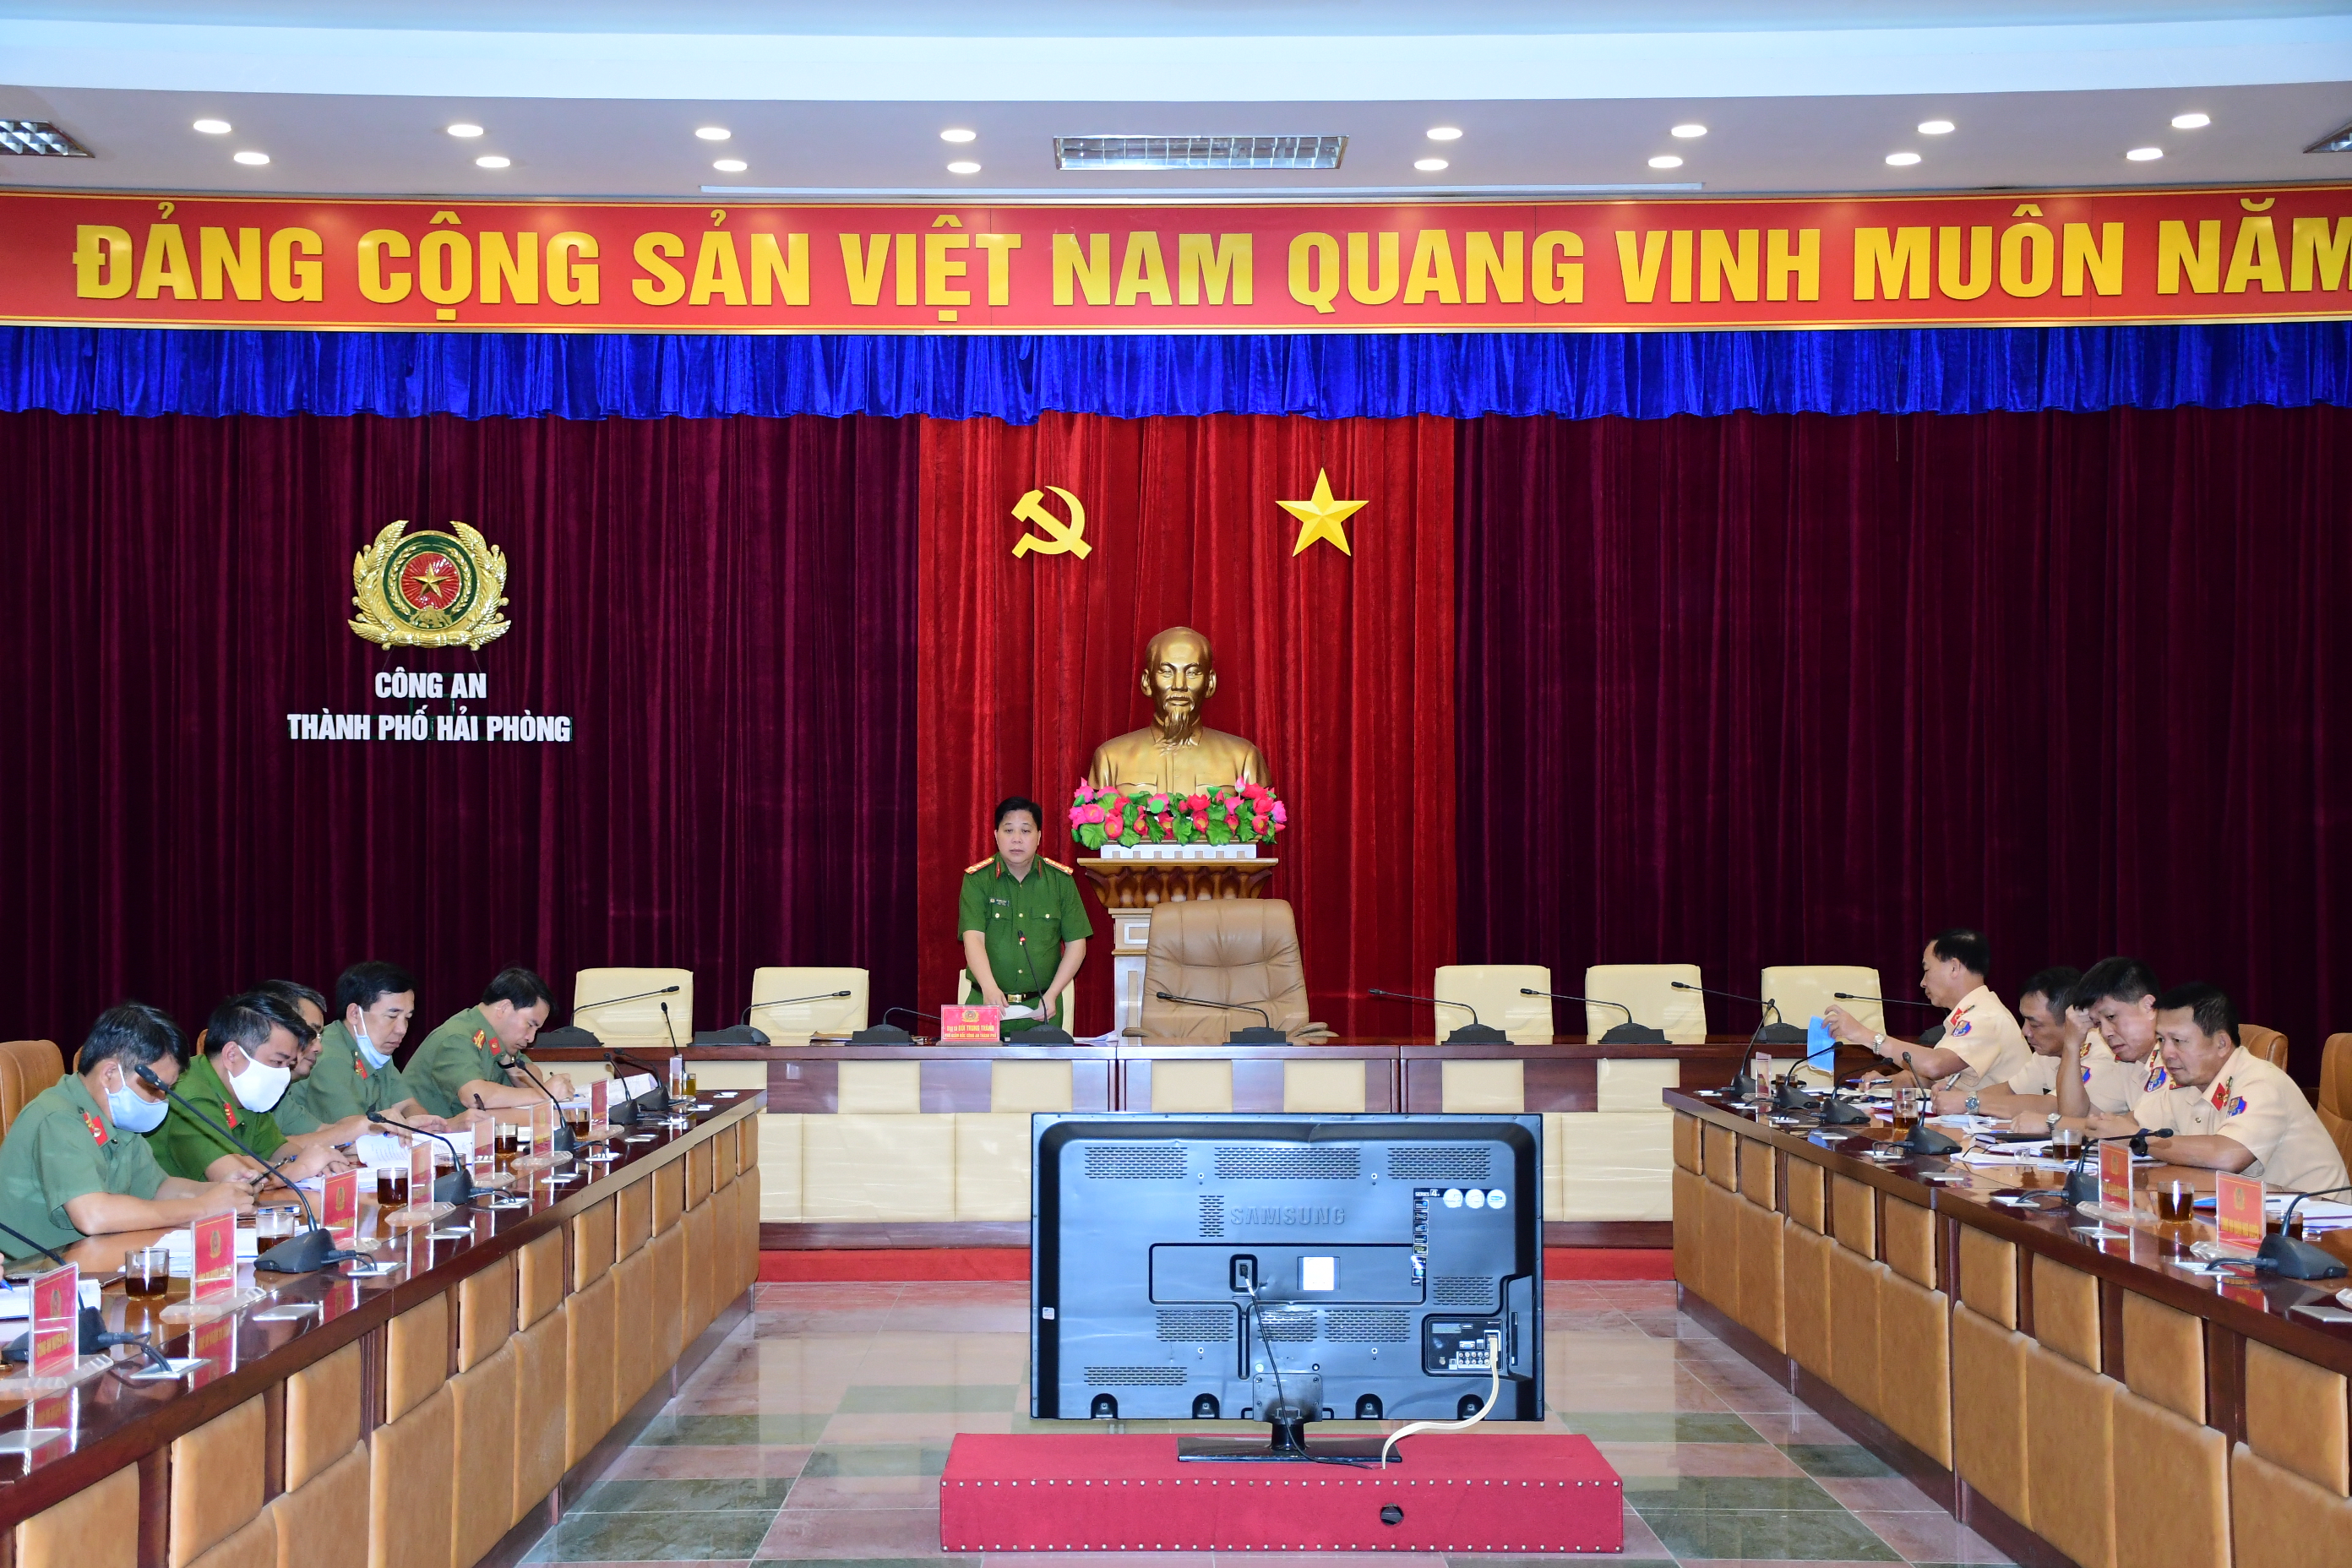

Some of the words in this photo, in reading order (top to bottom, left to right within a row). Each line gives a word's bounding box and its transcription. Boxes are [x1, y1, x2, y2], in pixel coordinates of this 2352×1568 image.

[73, 201, 324, 302] ĐẢNG
[357, 210, 601, 321] CỘNG
[631, 209, 810, 307] SẢN
[839, 214, 1021, 323] VIỆT
[1052, 231, 1254, 307] NAM
[1288, 229, 1585, 314] QUANG
[1614, 228, 1821, 303] VINH
[1853, 204, 2125, 301] MUÔN
[2156, 197, 2352, 295] NĂM
[374, 666, 444, 699] CÔNG
[449, 672, 487, 699] AN
[286, 708, 371, 740] THÀNH
[378, 704, 428, 741] PHỐ
[437, 705, 479, 741] HẢI
[486, 709, 572, 743] PHÒNG
[1230, 1206, 1346, 1225] SAMSUNG
